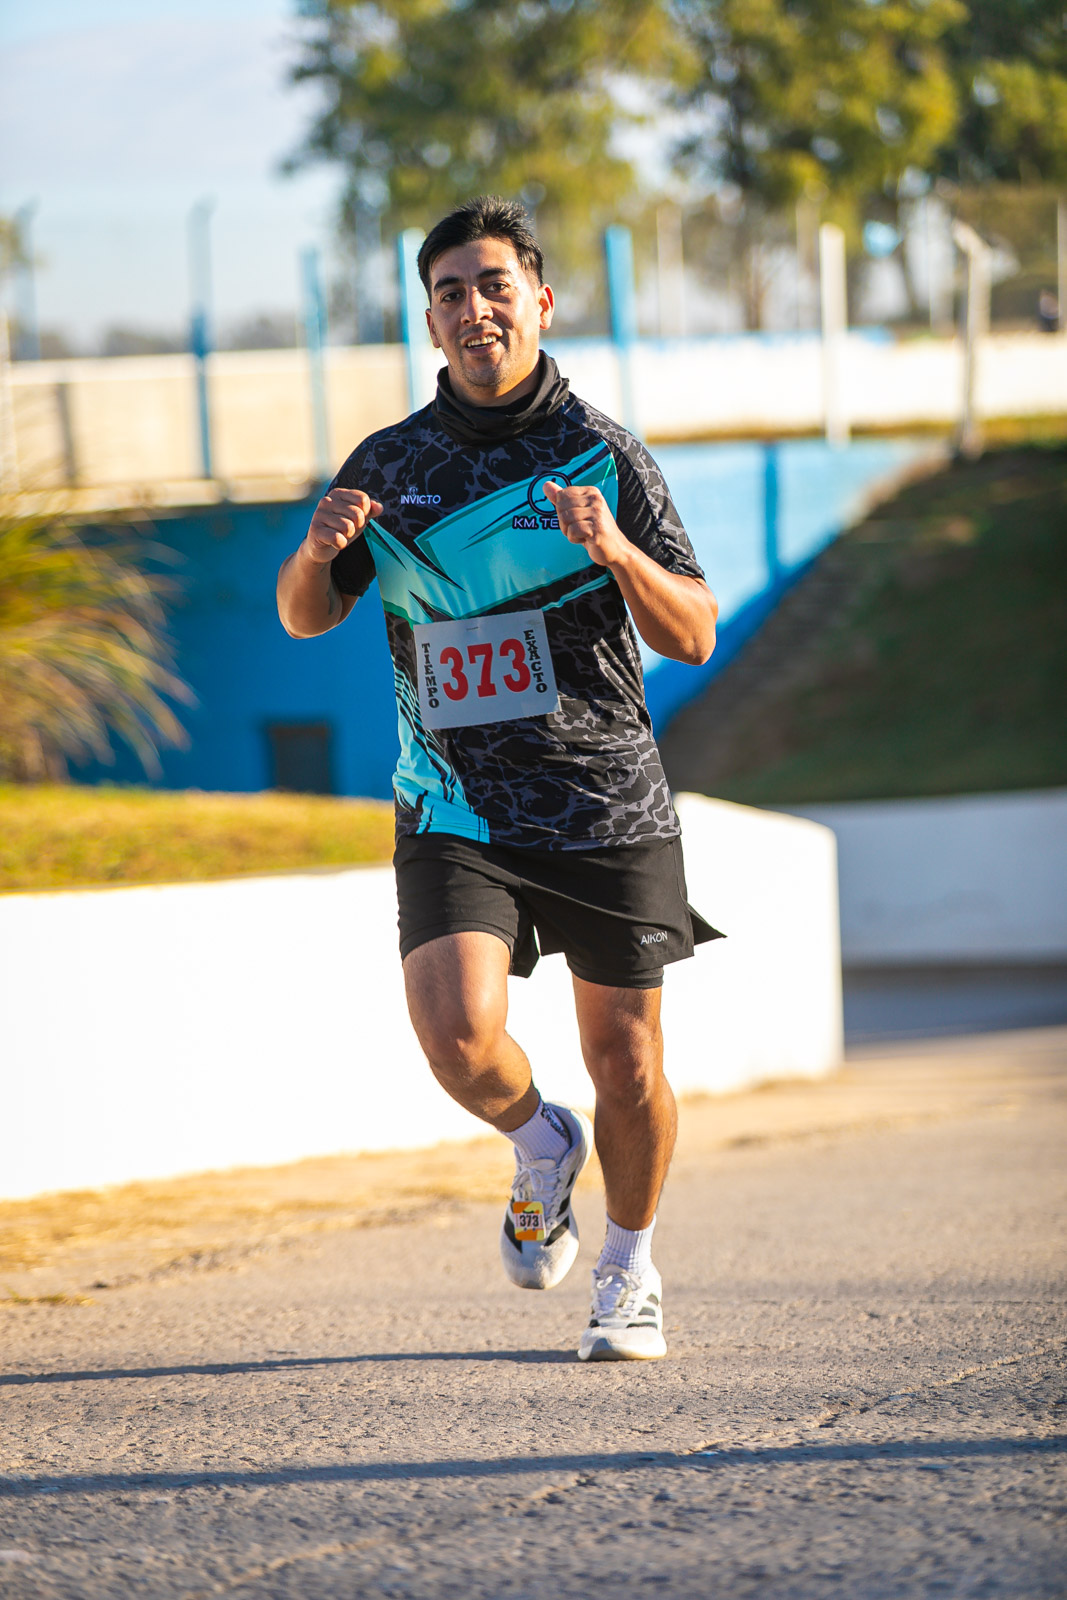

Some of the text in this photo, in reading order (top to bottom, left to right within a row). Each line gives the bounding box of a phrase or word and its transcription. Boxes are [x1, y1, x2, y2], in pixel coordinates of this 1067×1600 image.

[400, 494, 441, 504] INVICTO
[540, 516, 559, 529] TE
[523, 630, 547, 693] EXACTO
[422, 643, 439, 708] TIEMPO
[440, 638, 531, 701] 373
[640, 930, 668, 945] AIKON
[519, 1214, 539, 1227] 373
